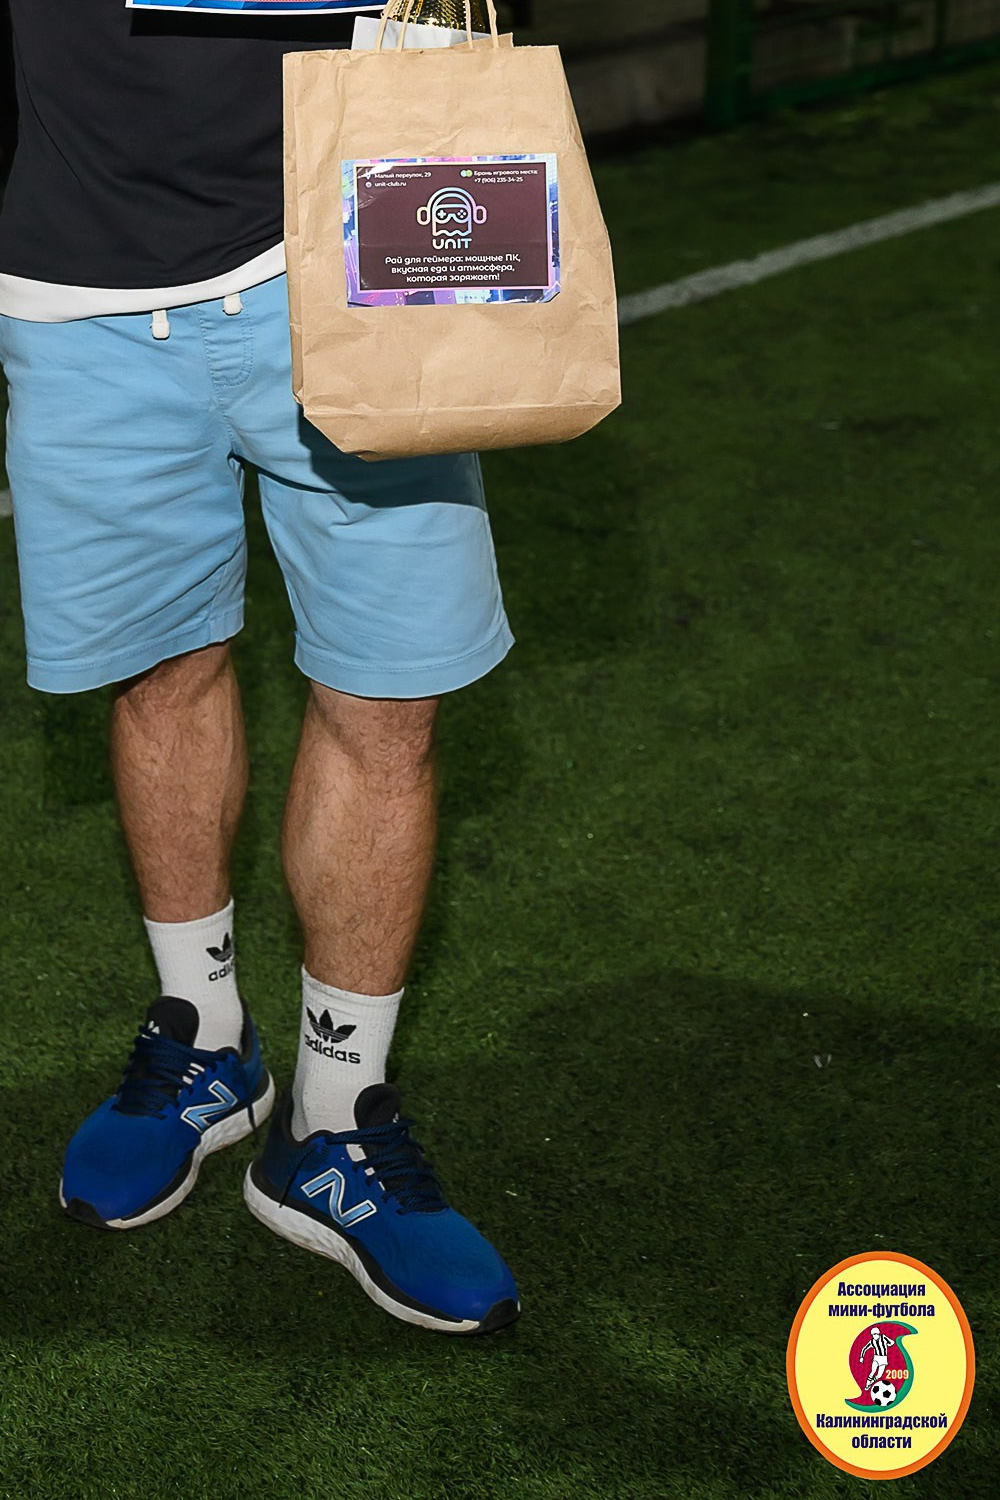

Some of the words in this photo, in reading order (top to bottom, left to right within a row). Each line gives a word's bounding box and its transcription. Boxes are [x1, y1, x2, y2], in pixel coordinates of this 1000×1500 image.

[432, 238, 472, 249] UNIT
[385, 256, 403, 264] Рай
[404, 257, 421, 265] для
[422, 255, 464, 264] геймера:
[465, 254, 504, 263] мощные
[505, 253, 521, 263] ПК,
[391, 266, 429, 274] вкусная
[430, 266, 448, 274] еда
[457, 263, 515, 273] атмосфера,
[406, 274, 448, 283] которая
[449, 273, 500, 283] заряжает!
[305, 1034, 361, 1064] adidas
